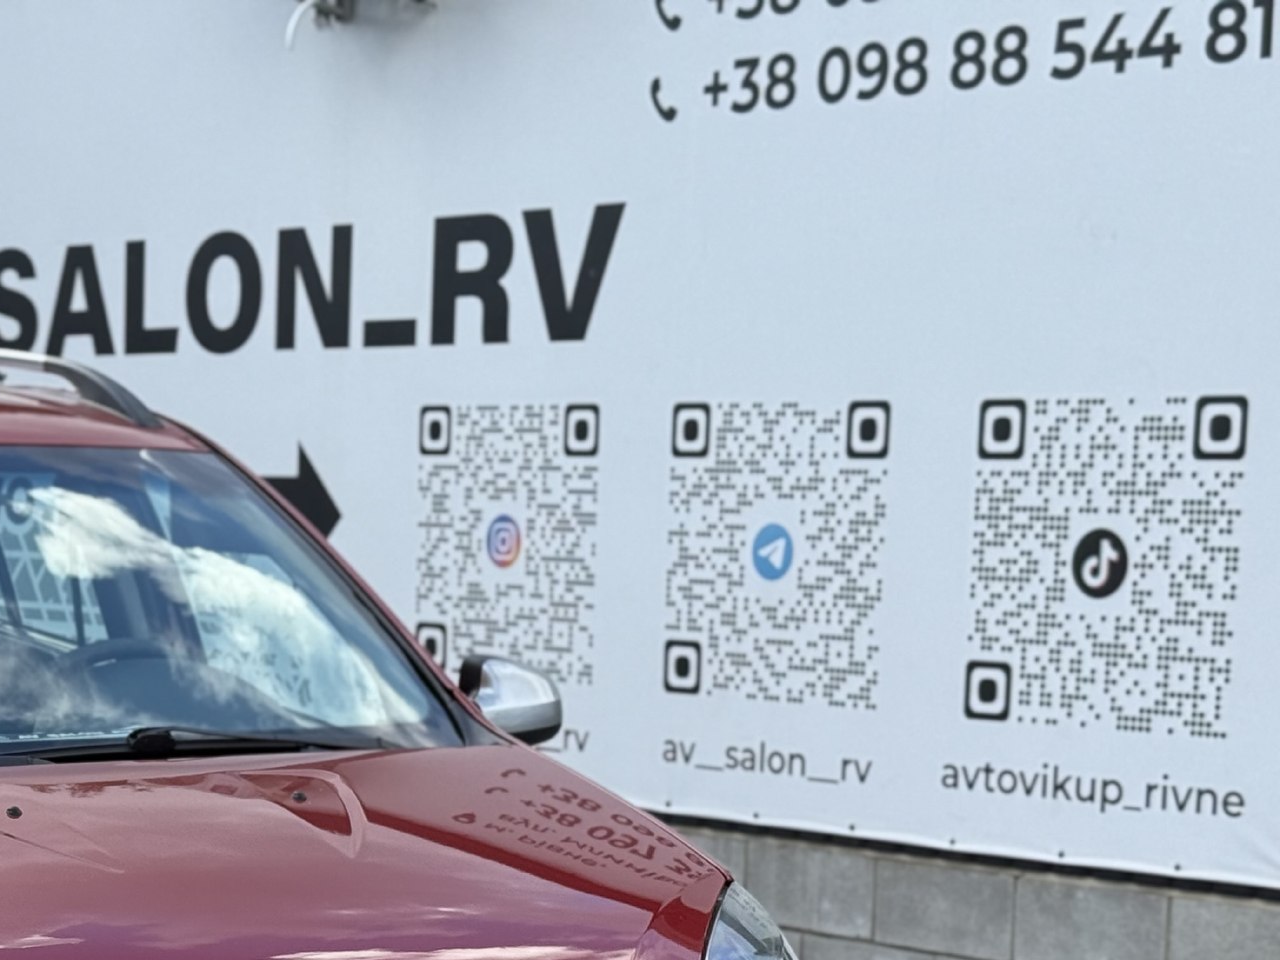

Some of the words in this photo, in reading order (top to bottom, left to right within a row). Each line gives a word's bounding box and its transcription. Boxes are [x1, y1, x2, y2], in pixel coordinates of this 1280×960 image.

[703, 53, 797, 114] +38
[817, 37, 929, 104] 098
[950, 25, 1029, 90] 88
[1050, 7, 1182, 80] 544
[1205, 0, 1275, 64] 81
[663, 739, 873, 784] av_salon_rv
[940, 761, 1246, 818] avtovikup_rivne
